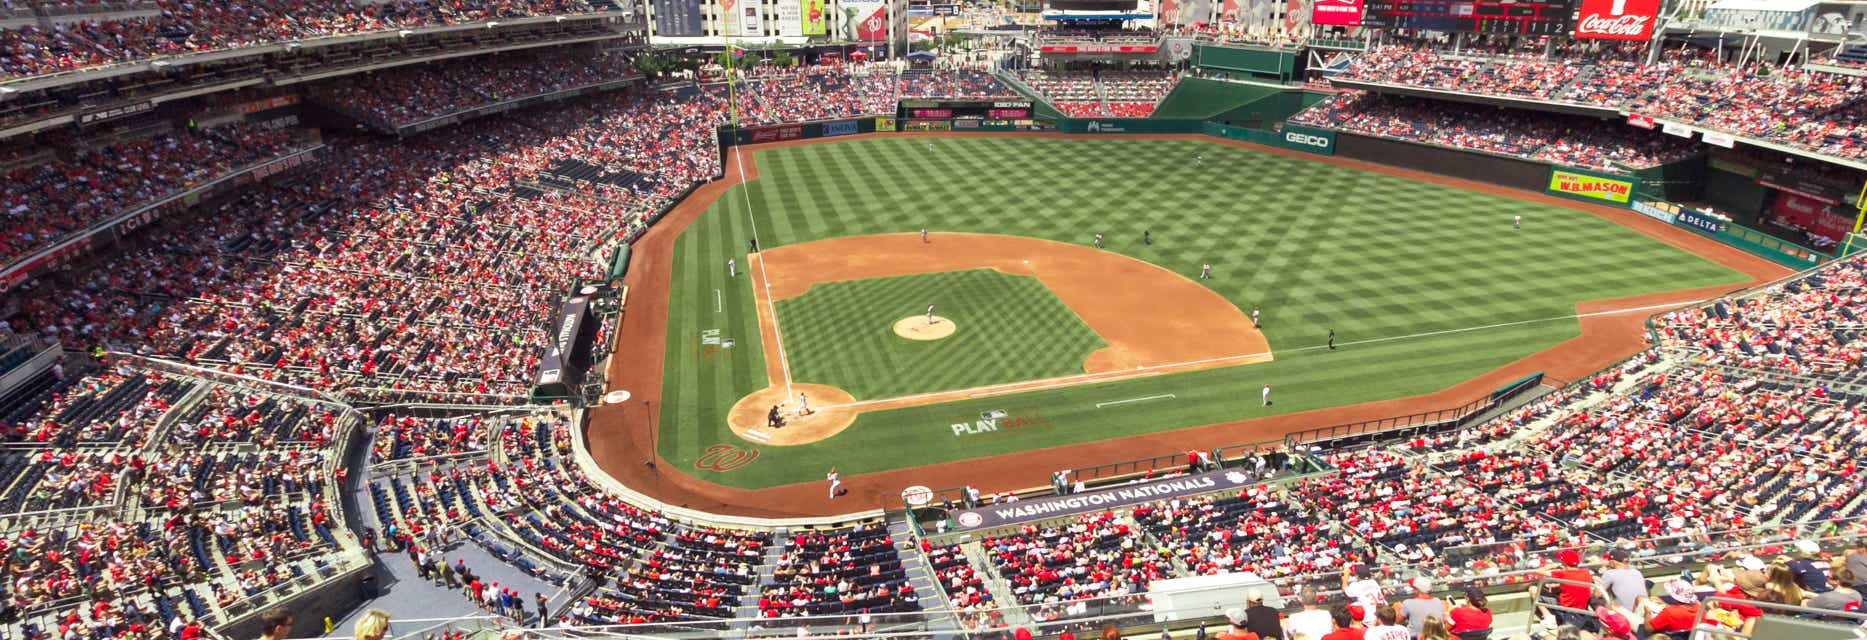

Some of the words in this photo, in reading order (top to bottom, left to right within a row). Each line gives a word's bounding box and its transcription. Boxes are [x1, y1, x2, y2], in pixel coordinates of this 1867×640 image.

[1555, 23, 1563, 33] 2
[1286, 132, 1329, 148] GEICO
[1687, 215, 1717, 231] DELTA
[951, 419, 998, 436] PLAY
[996, 492, 1118, 520] WASHINGTON
[1118, 477, 1216, 504] NATIONALS
